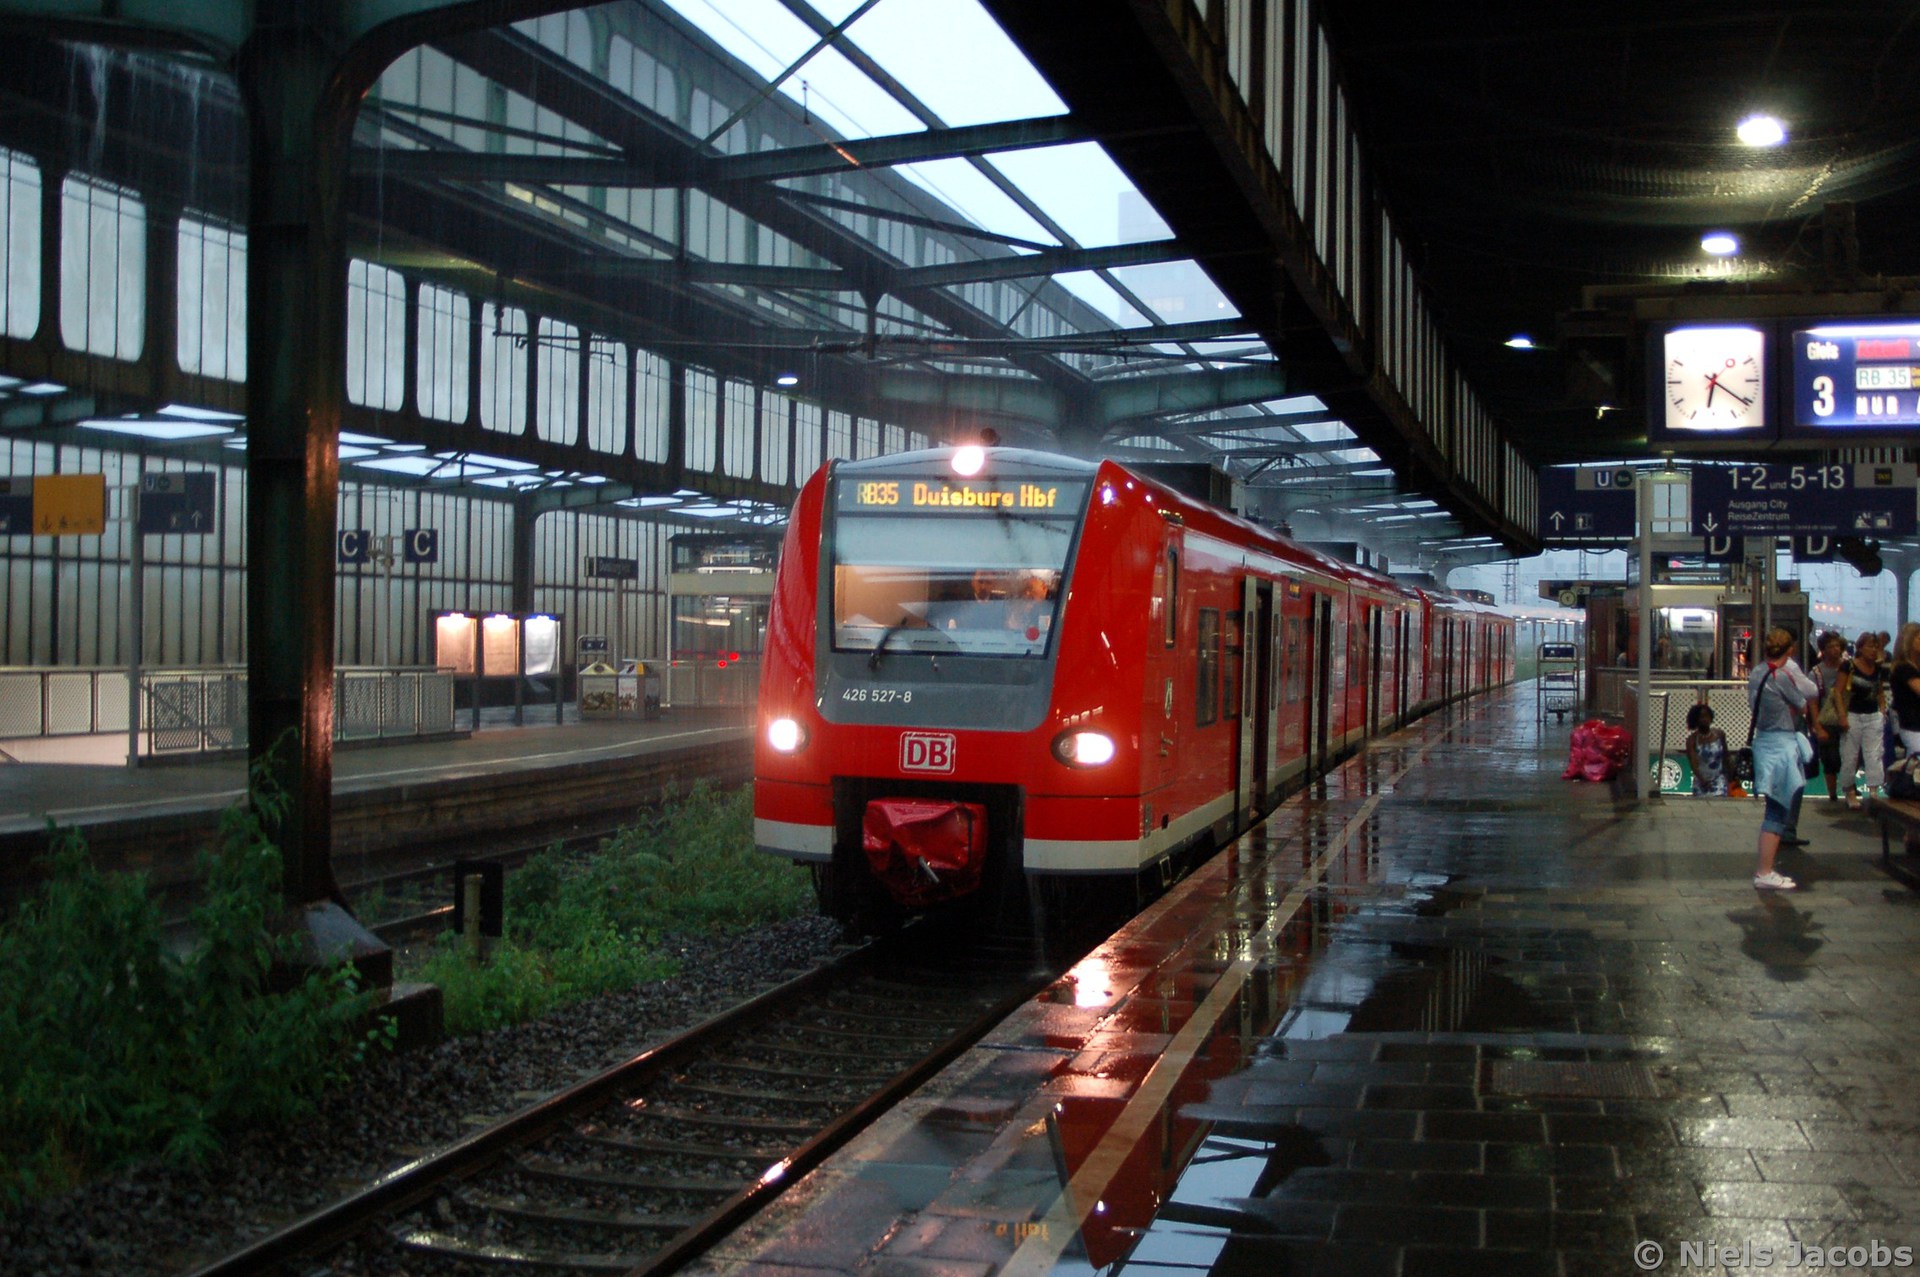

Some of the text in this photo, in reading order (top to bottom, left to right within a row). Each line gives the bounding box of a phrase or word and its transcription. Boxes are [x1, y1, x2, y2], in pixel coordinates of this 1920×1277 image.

[1858, 369, 1907, 386] RB 35
[1812, 375, 1835, 417] 3
[1728, 467, 1767, 490] 1-2
[1790, 466, 1845, 490] 5-13
[857, 482, 1057, 508] RB35 Duisburg Hbf
[1728, 500, 1788, 511] Ausgang City
[342, 531, 359, 558] C
[414, 530, 431, 557] C
[842, 688, 912, 703] 426 527-8
[907, 741, 948, 768] DB
